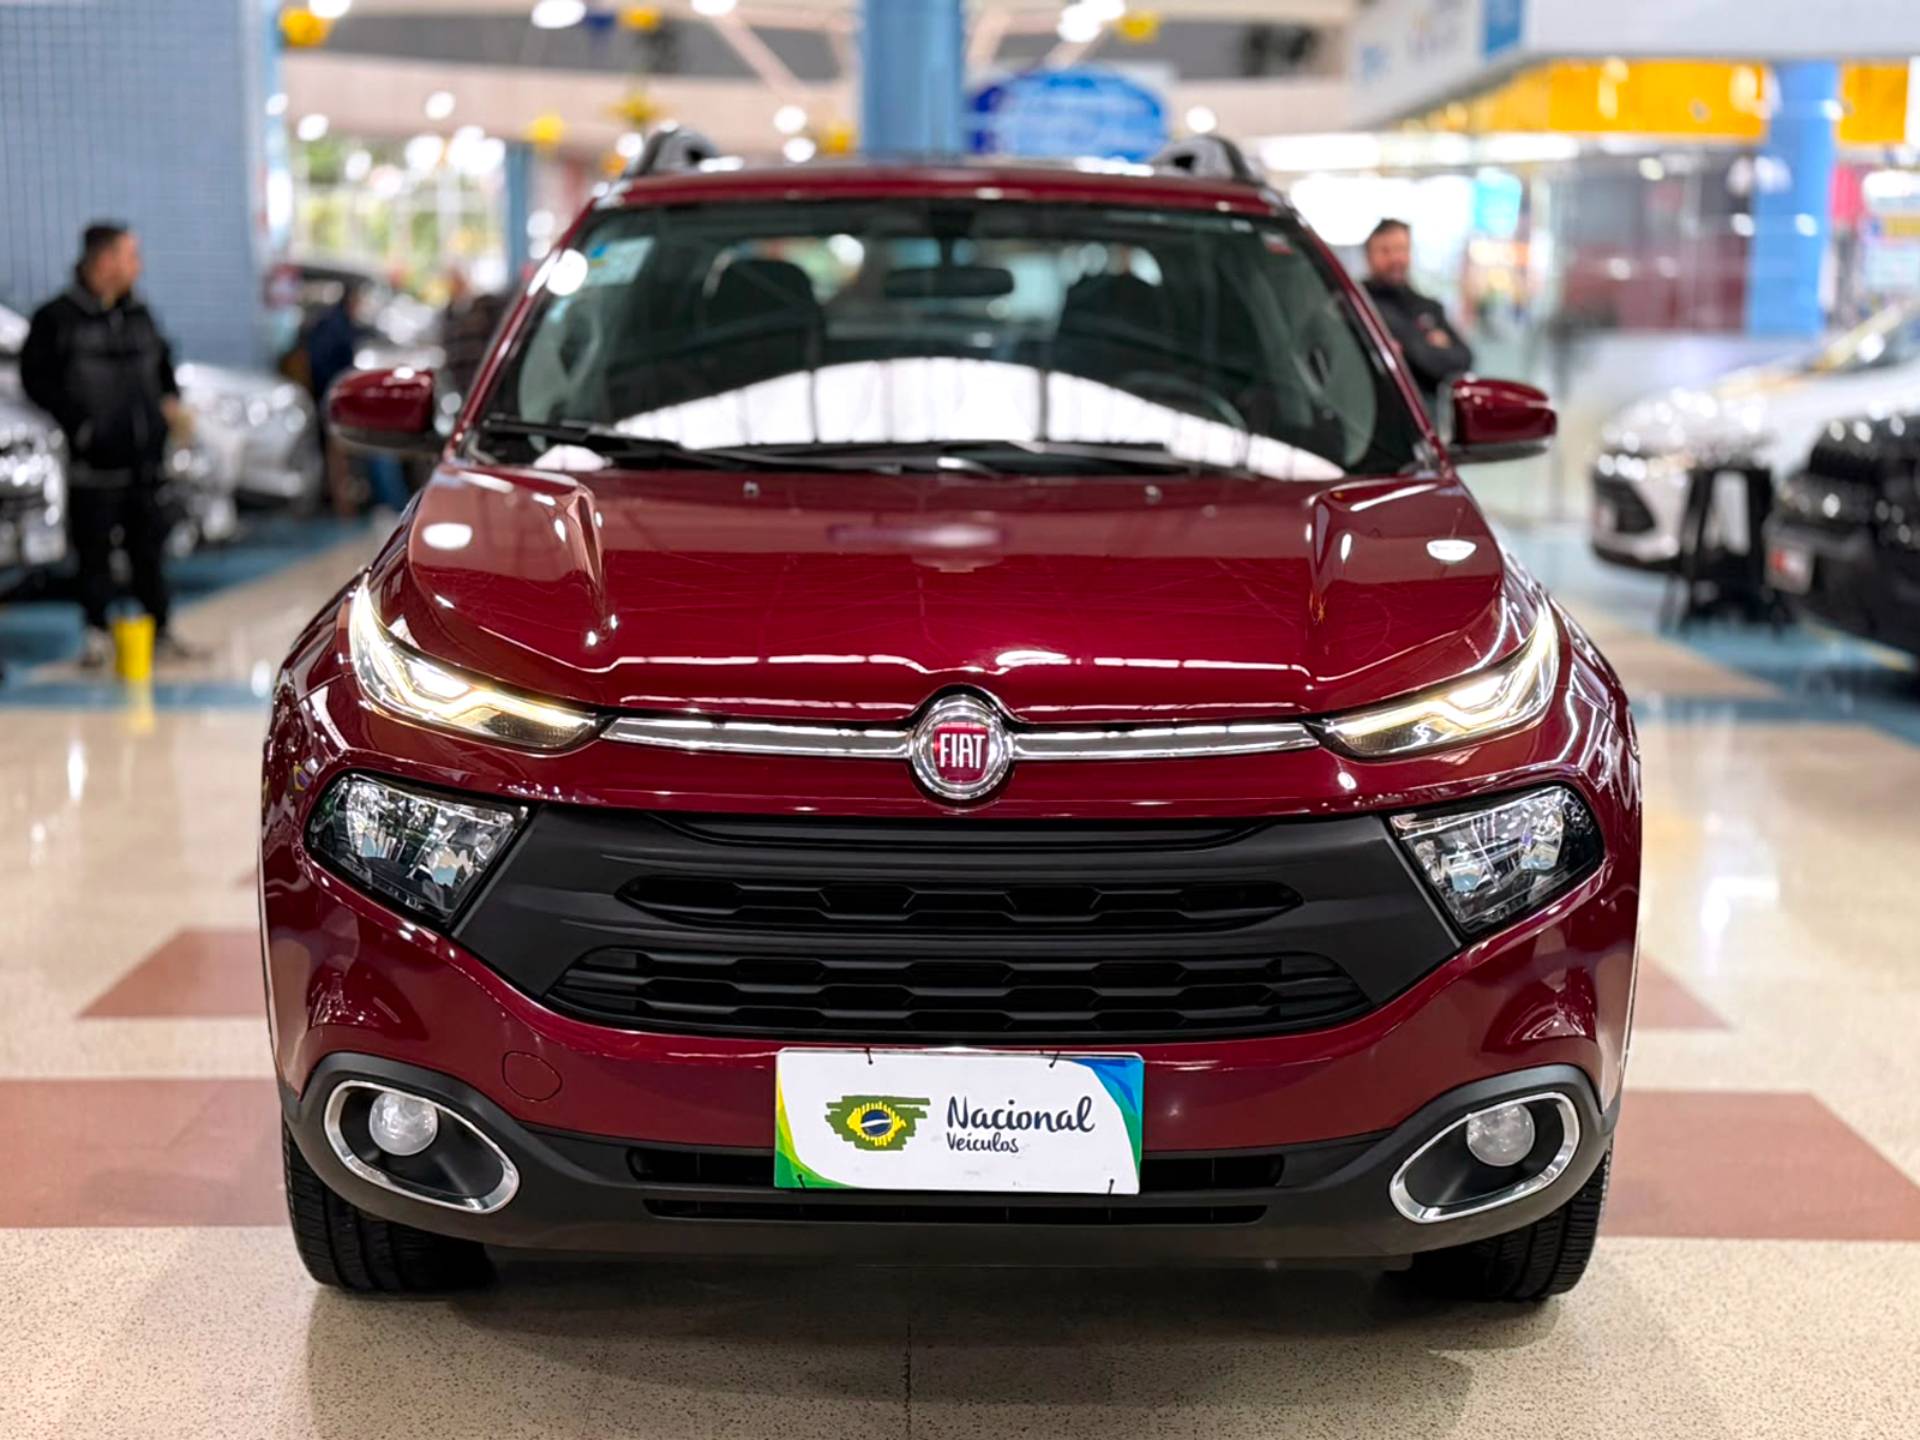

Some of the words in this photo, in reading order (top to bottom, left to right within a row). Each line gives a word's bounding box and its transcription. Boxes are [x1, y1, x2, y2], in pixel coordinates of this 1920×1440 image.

[939, 733, 986, 769] FIAT
[947, 1096, 1095, 1133] Nacional
[947, 1132, 1019, 1153] Veículos
